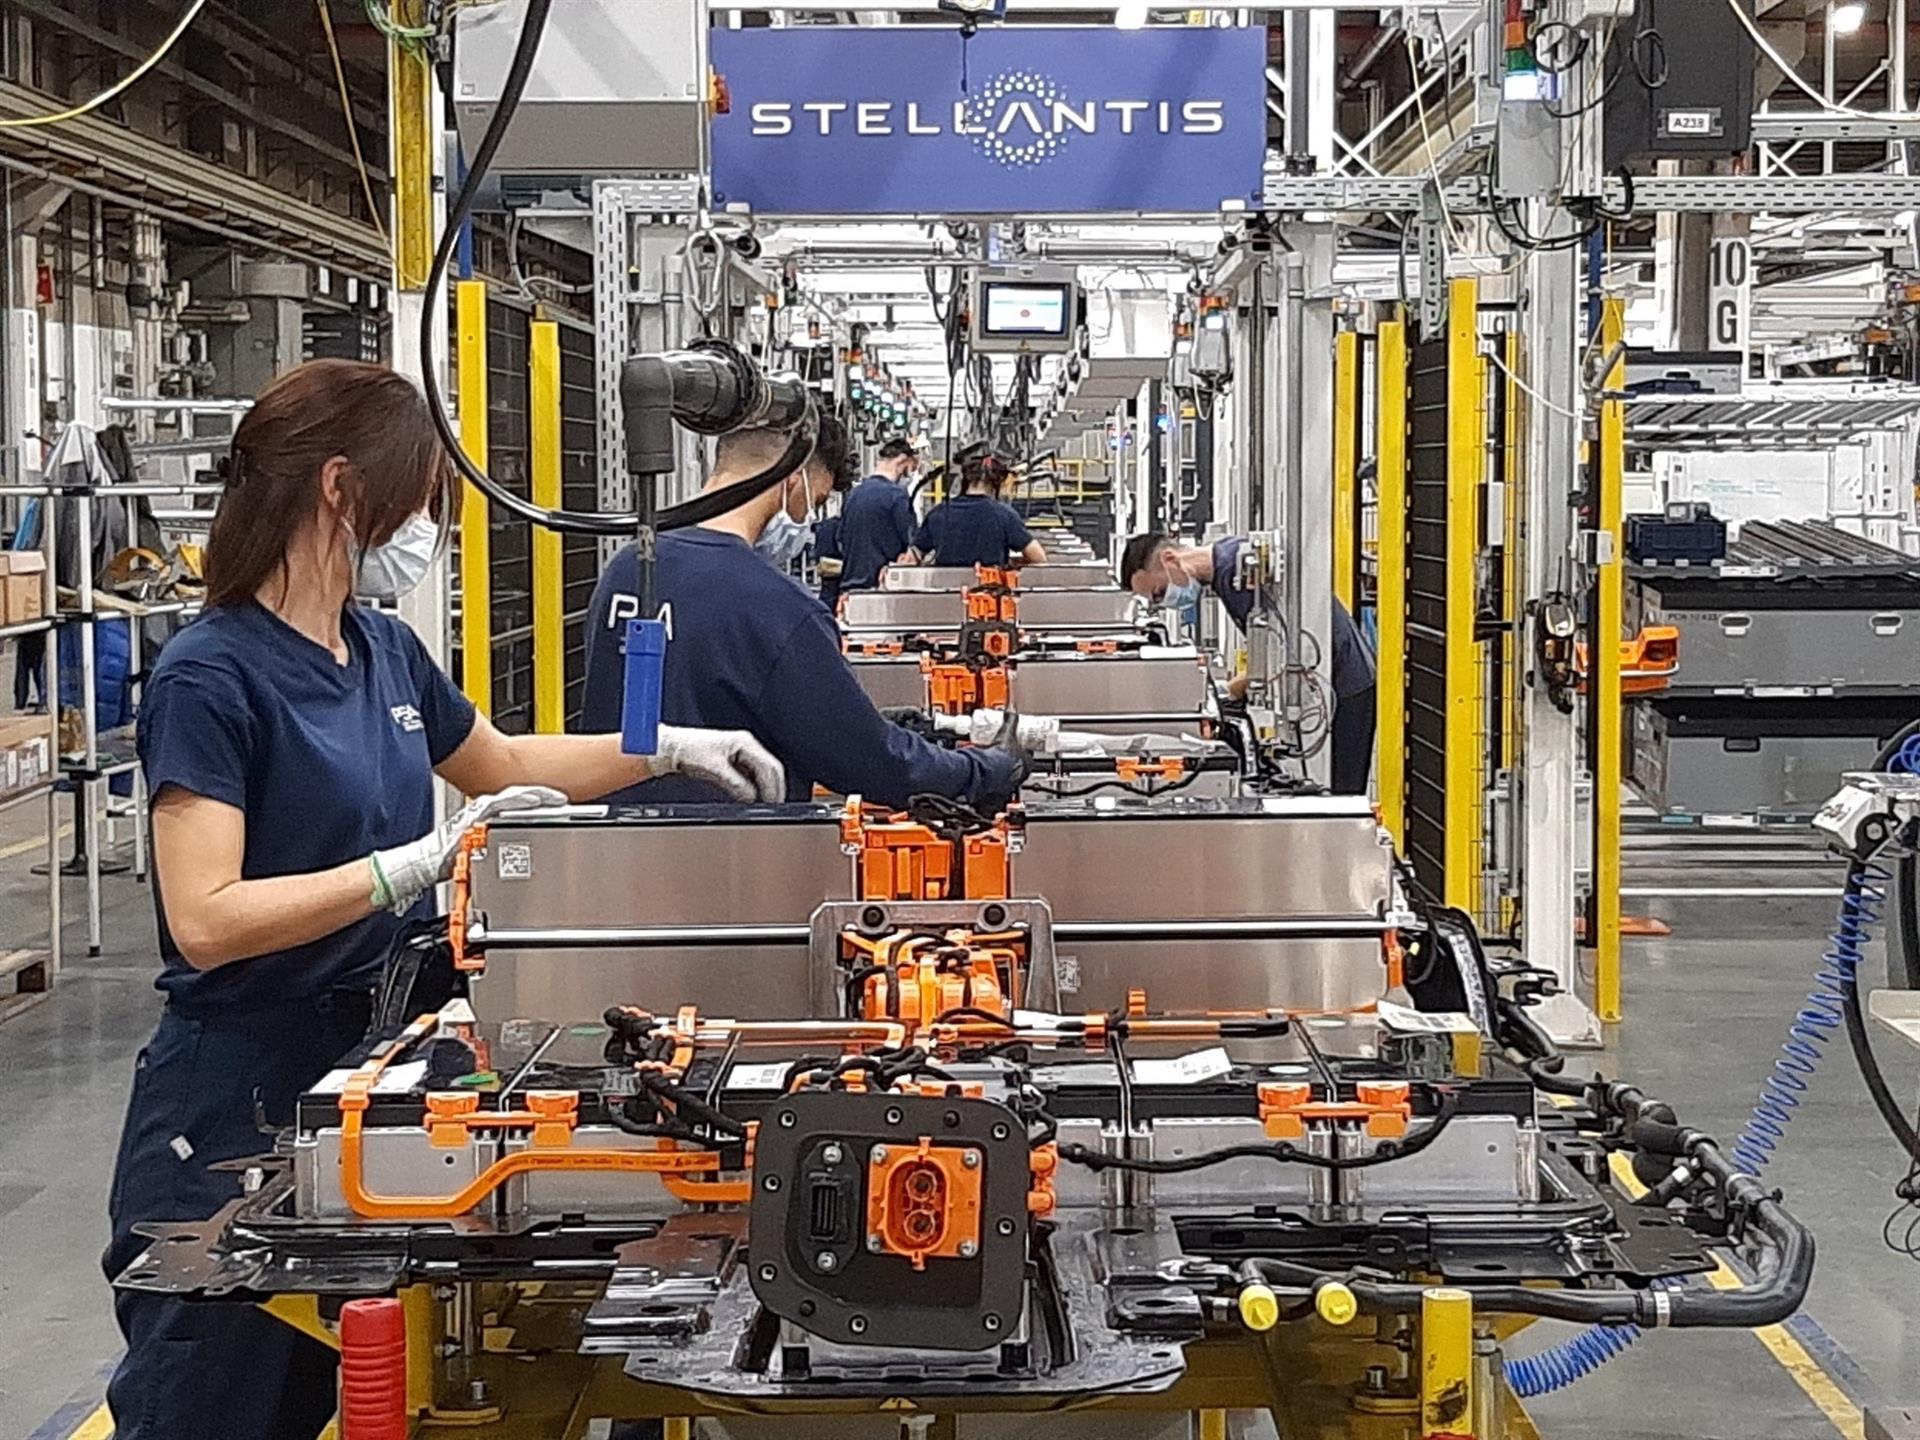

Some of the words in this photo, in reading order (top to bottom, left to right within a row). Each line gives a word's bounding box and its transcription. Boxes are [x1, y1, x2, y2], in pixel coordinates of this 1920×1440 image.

[751, 102, 1225, 135] STELLANTIS
[1710, 241, 1746, 287] 10
[1717, 300, 1737, 344] G
[608, 593, 673, 640] PA
